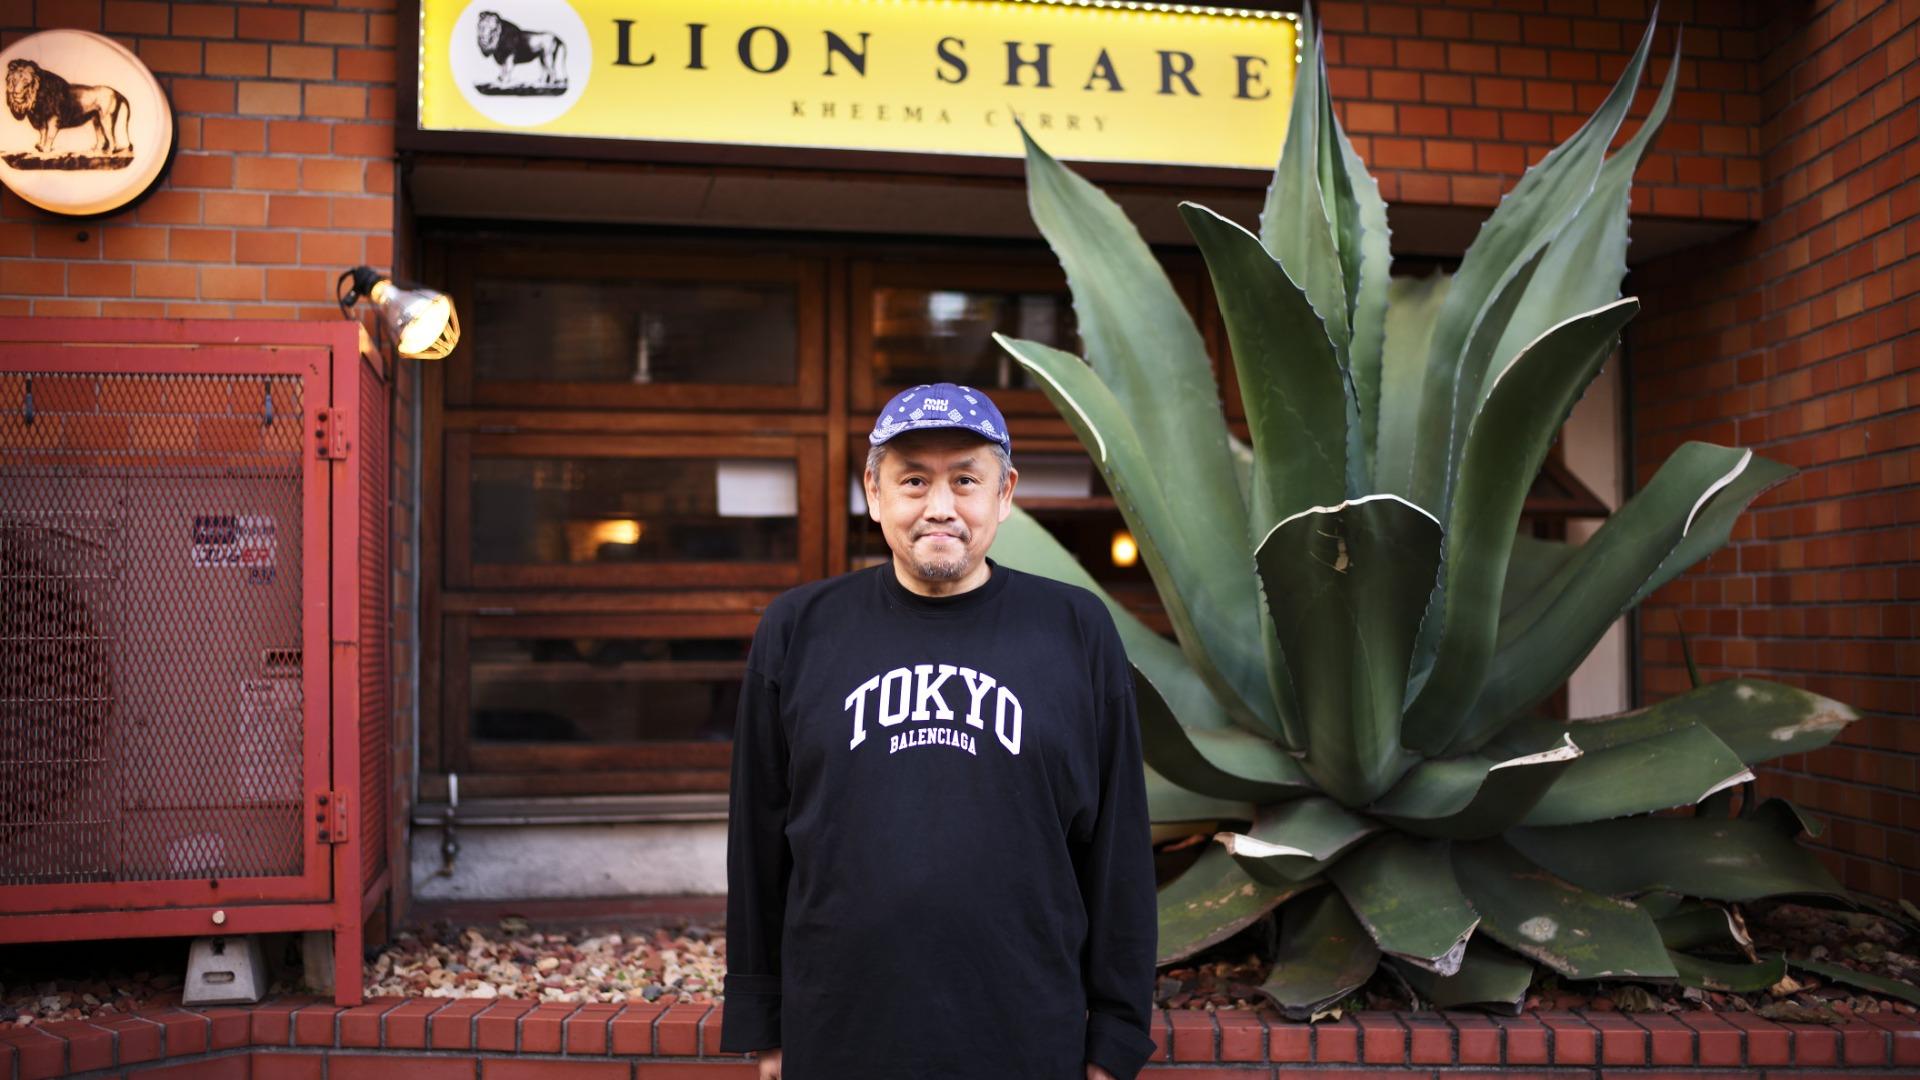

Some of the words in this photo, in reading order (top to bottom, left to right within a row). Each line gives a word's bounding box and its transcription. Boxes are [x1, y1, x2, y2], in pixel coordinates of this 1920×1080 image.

[611, 19, 872, 77] LION
[936, 36, 1272, 101] SHARE
[791, 101, 951, 124] KHEEMA
[844, 664, 1023, 755] TOKYO
[889, 727, 977, 756] BALENCIAGA
